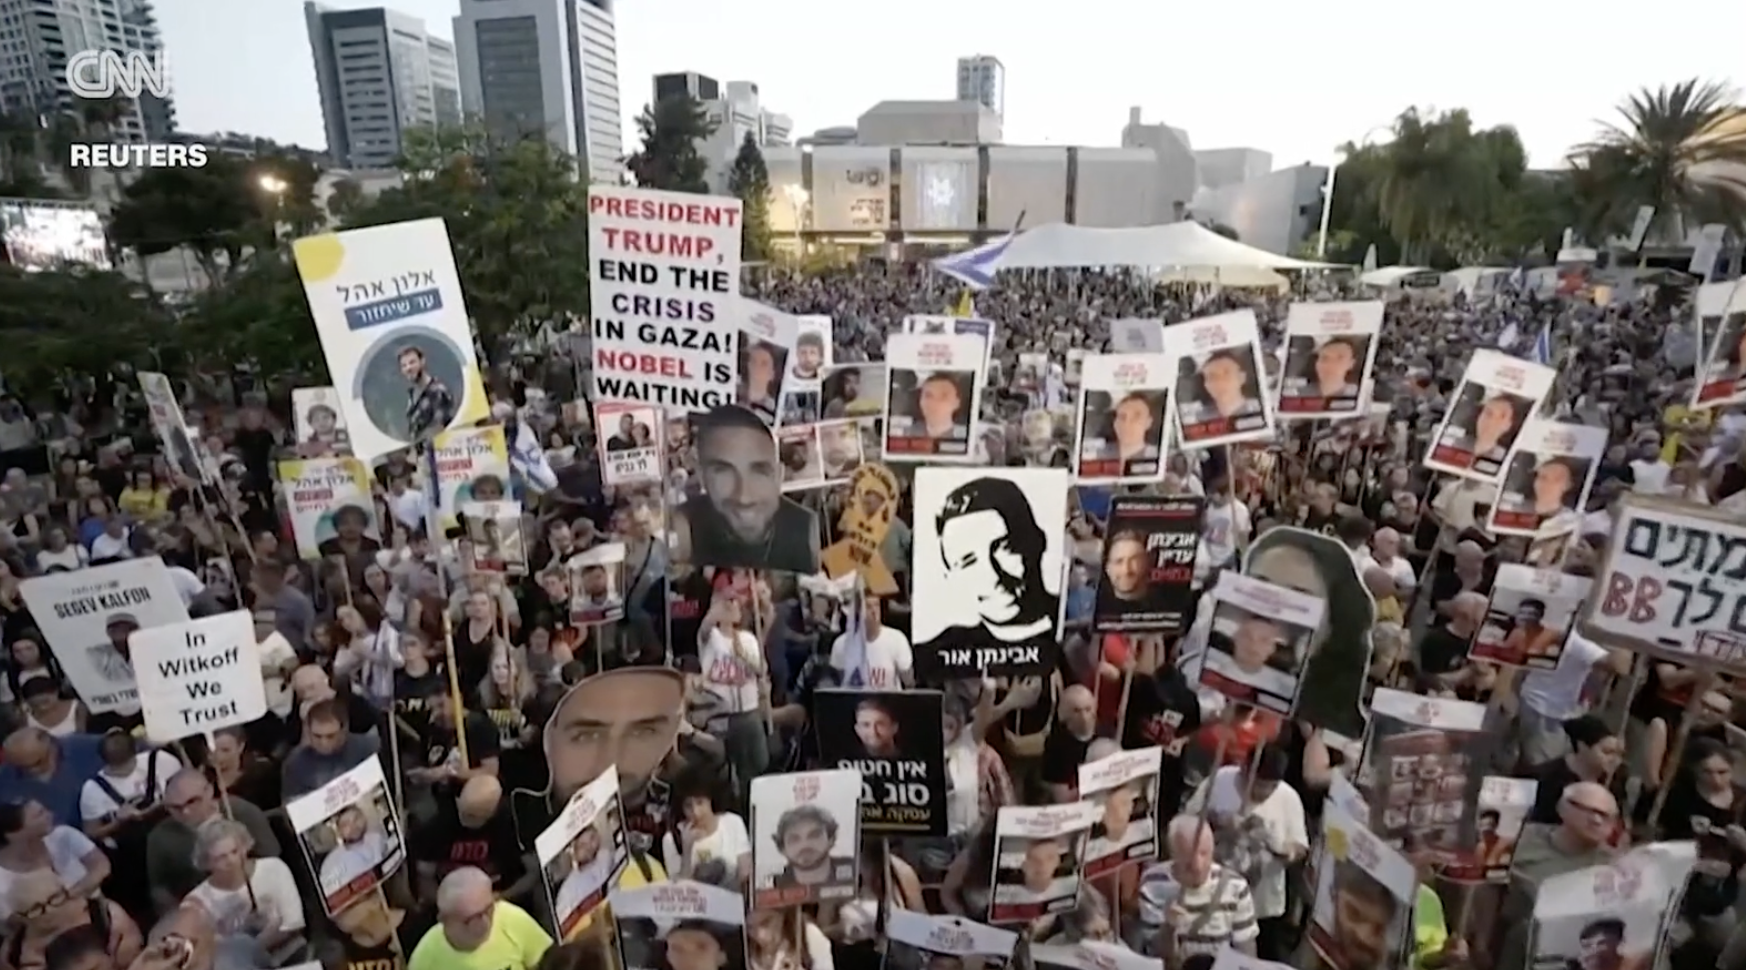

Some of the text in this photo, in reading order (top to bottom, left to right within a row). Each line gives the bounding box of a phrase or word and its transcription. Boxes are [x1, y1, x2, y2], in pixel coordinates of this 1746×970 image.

[589, 194, 740, 228] PRESIDENT
[602, 226, 724, 266] TRUMP,
[336, 269, 436, 304] אלון אהל
[600, 258, 730, 293] END THE
[356, 293, 435, 324] עד שיחזור
[611, 292, 715, 323] CRISIS
[595, 318, 625, 341] IN
[637, 322, 732, 353] GAZA!
[597, 348, 731, 385] NOBEL IS
[597, 376, 732, 409] WAITING!
[54, 597, 97, 619] SEGEV
[98, 586, 151, 610] KALFON
[1601, 571, 1662, 624] BB
[185, 630, 205, 648] In
[158, 645, 238, 678] Witkoff
[938, 645, 1040, 670] אבינתן אור
[185, 680, 221, 699] We
[179, 699, 237, 725] Trust
[896, 760, 927, 780] אין
[882, 783, 930, 806] סוג
